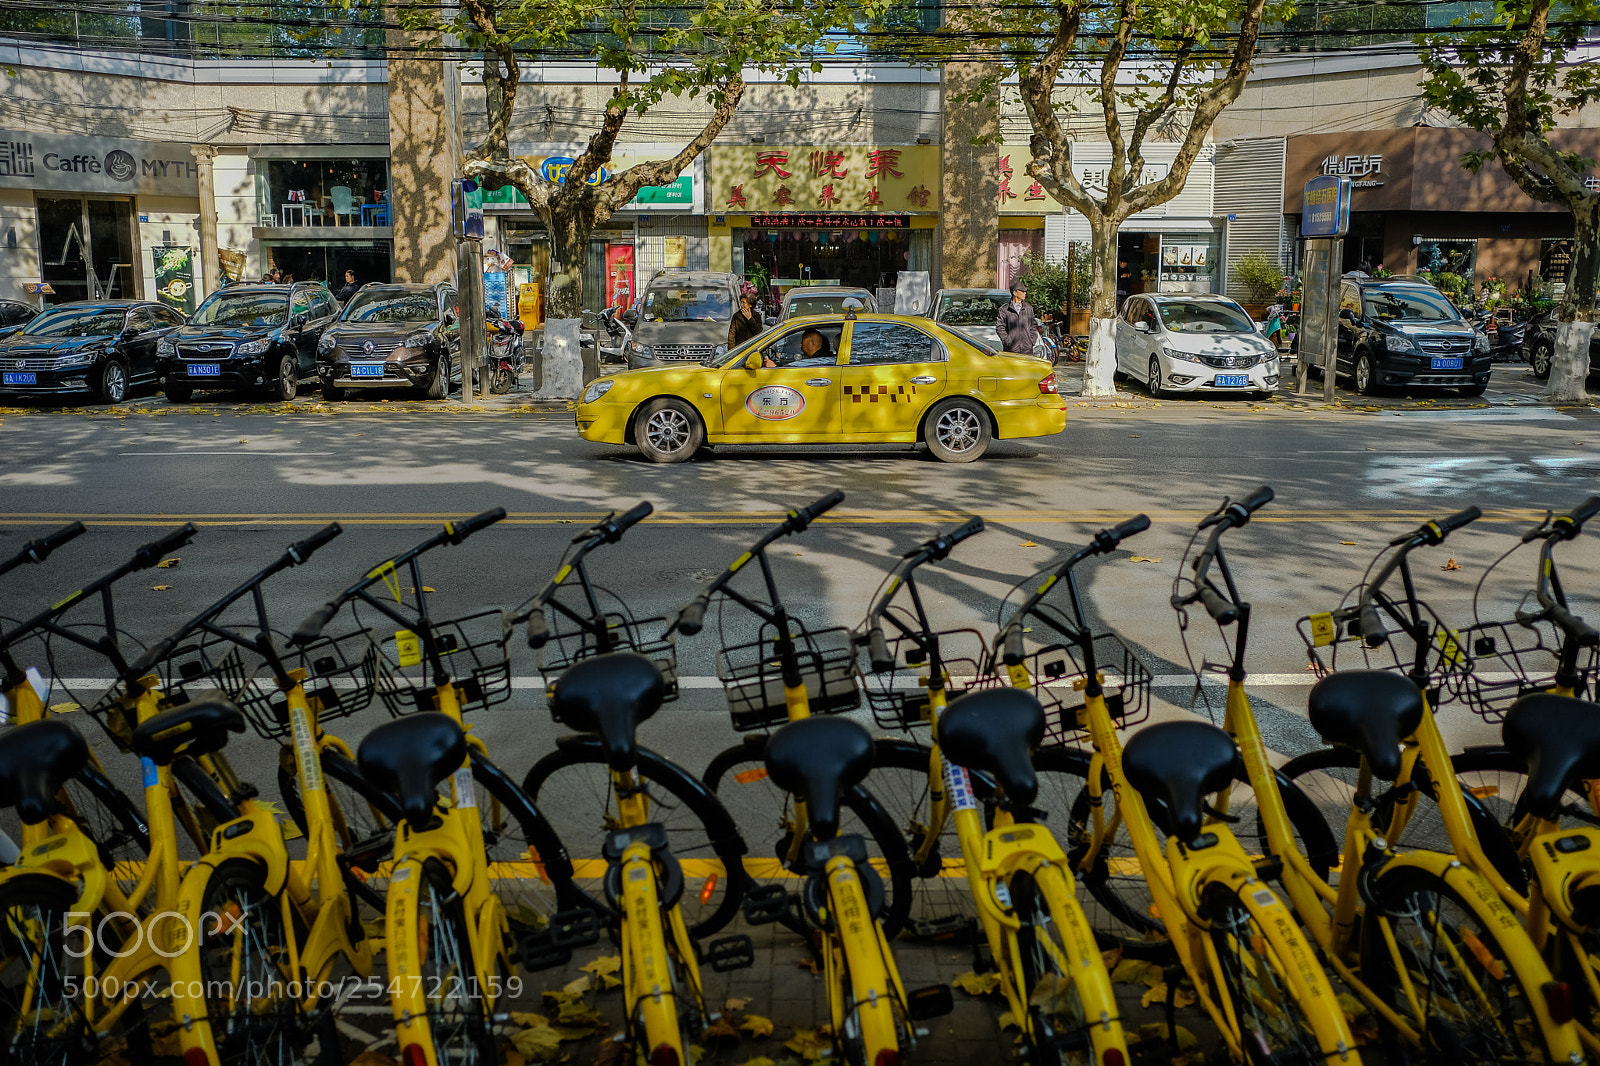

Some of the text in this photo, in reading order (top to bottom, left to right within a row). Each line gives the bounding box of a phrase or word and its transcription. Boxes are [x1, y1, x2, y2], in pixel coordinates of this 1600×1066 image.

[43, 152, 101, 174] Caffè
[754, 149, 904, 180] 天悦莱
[726, 183, 931, 209] 美容养生馆
